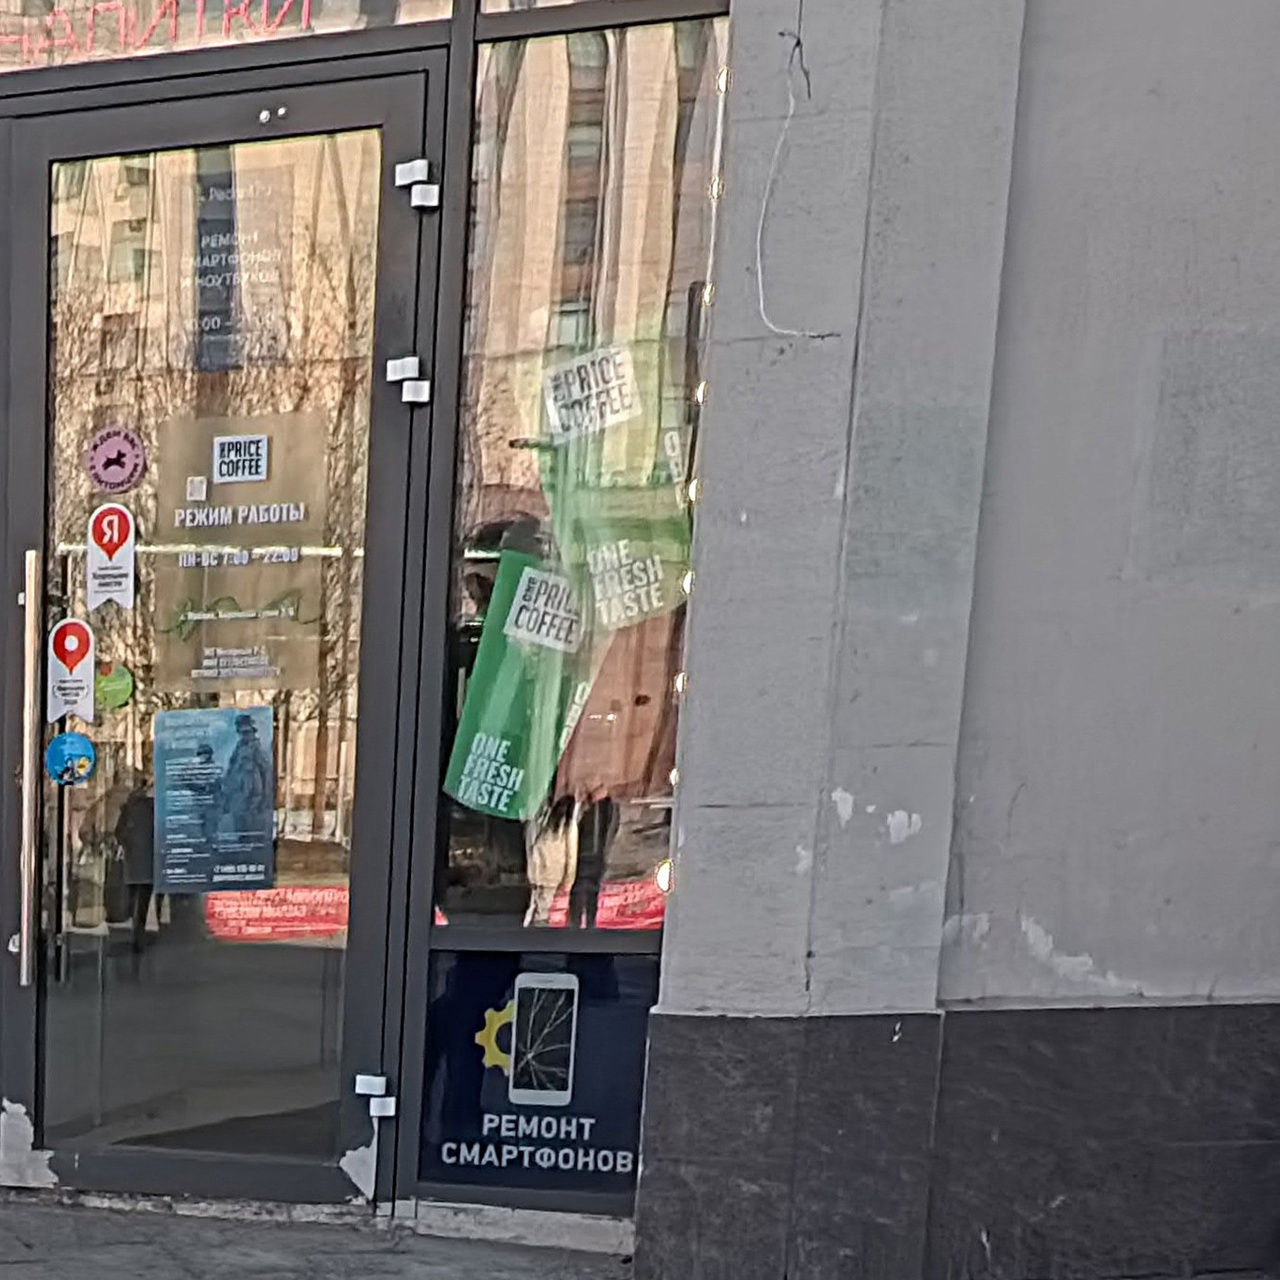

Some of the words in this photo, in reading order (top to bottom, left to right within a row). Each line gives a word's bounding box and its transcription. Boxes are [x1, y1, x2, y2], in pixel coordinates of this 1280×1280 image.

[563, 350, 626, 401] PRICE
[227, 439, 263, 458] PRICE
[219, 458, 263, 478] COFFEE
[101, 515, 119, 544] Я
[174, 506, 233, 528] РЕЖИМ
[237, 501, 305, 526] РАБОТЫ
[592, 555, 664, 602] FRESH
[596, 586, 665, 626] TASTE
[514, 605, 576, 646] COFFEE
[471, 732, 512, 763] ONE
[463, 756, 524, 792] FRESH
[457, 776, 514, 813] TASTE
[482, 1113, 596, 1141] РЕМОНТ
[441, 1142, 634, 1173] СМАРТФОНОВ
